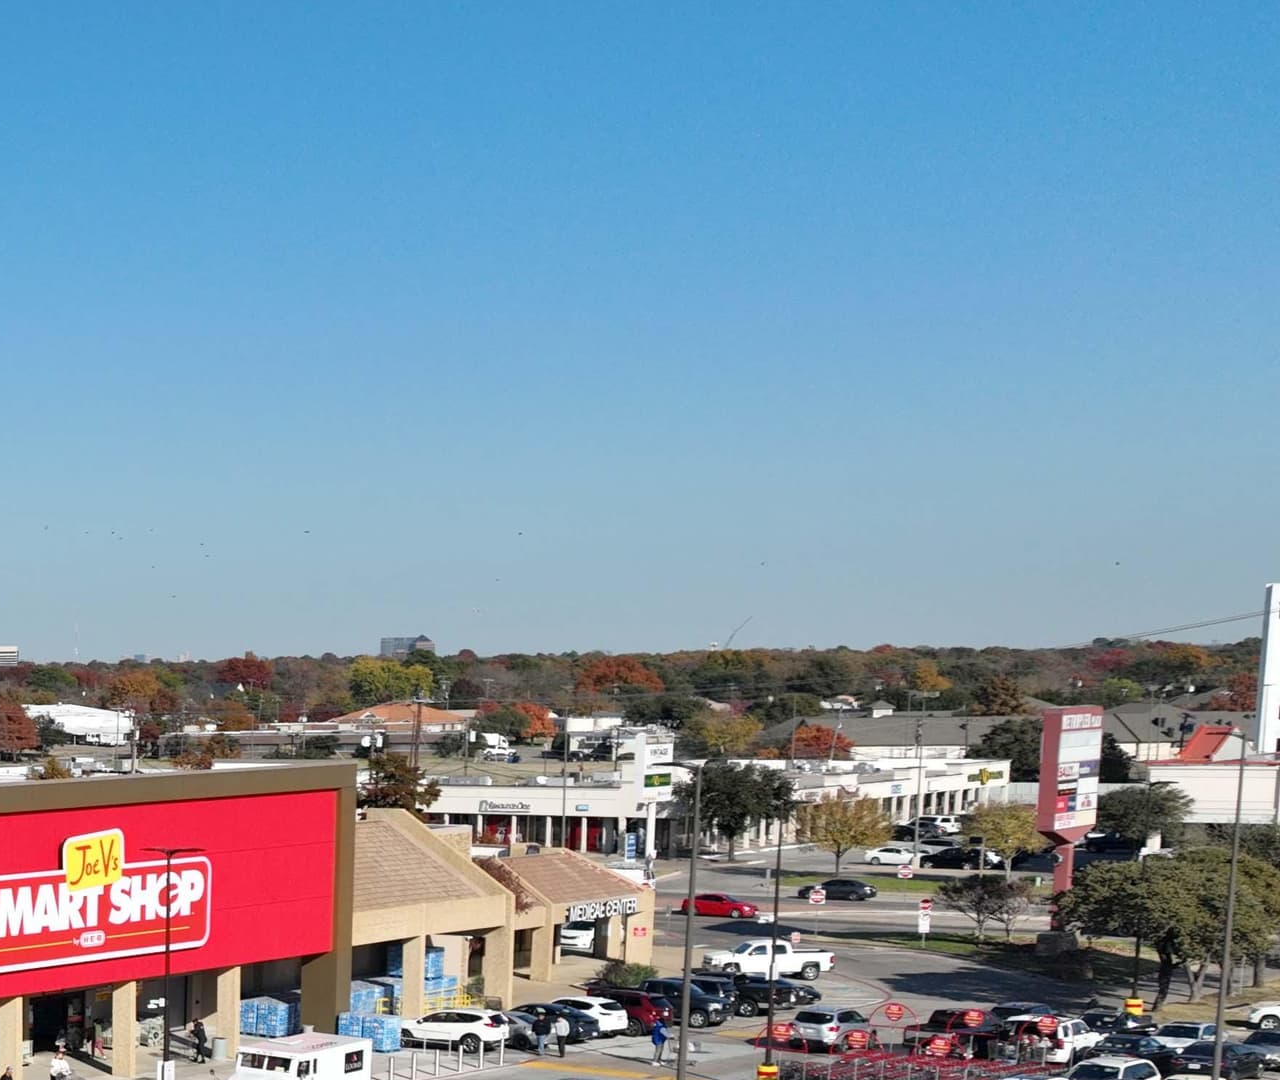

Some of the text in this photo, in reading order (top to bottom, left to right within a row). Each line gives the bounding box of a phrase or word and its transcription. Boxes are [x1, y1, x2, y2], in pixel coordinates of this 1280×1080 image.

[108, 869, 205, 925] SHOP
[569, 897, 638, 922] MEDICAL CENTER
